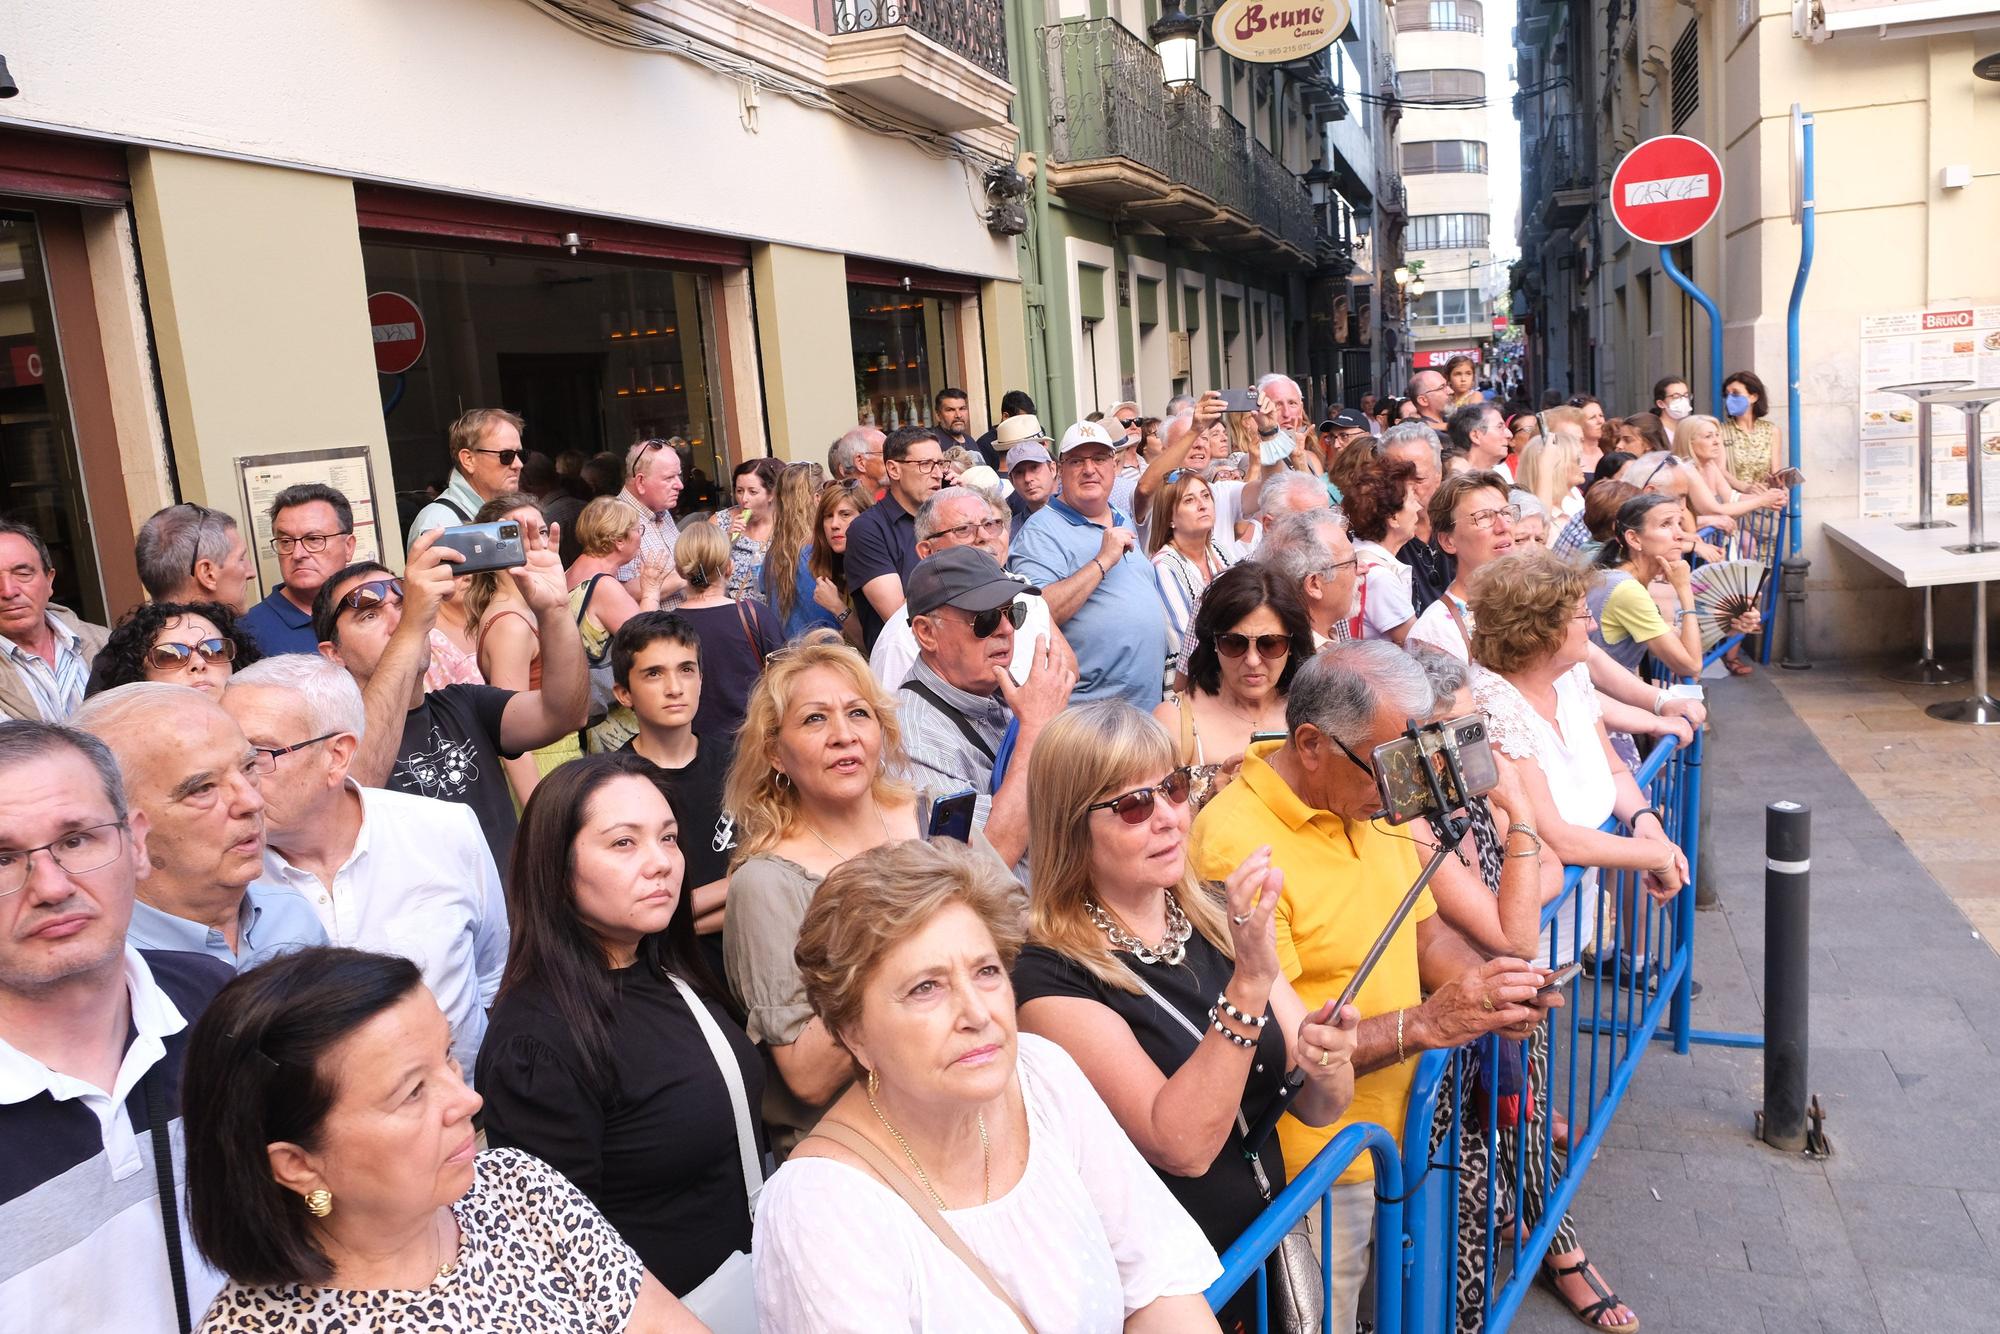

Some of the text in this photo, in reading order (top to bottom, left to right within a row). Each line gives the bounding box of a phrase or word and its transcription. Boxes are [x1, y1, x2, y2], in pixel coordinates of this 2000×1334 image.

[1235, 4, 1324, 40] Bruno
[1293, 27, 1324, 38] Caruso
[1926, 312, 1969, 328] BRUNO
